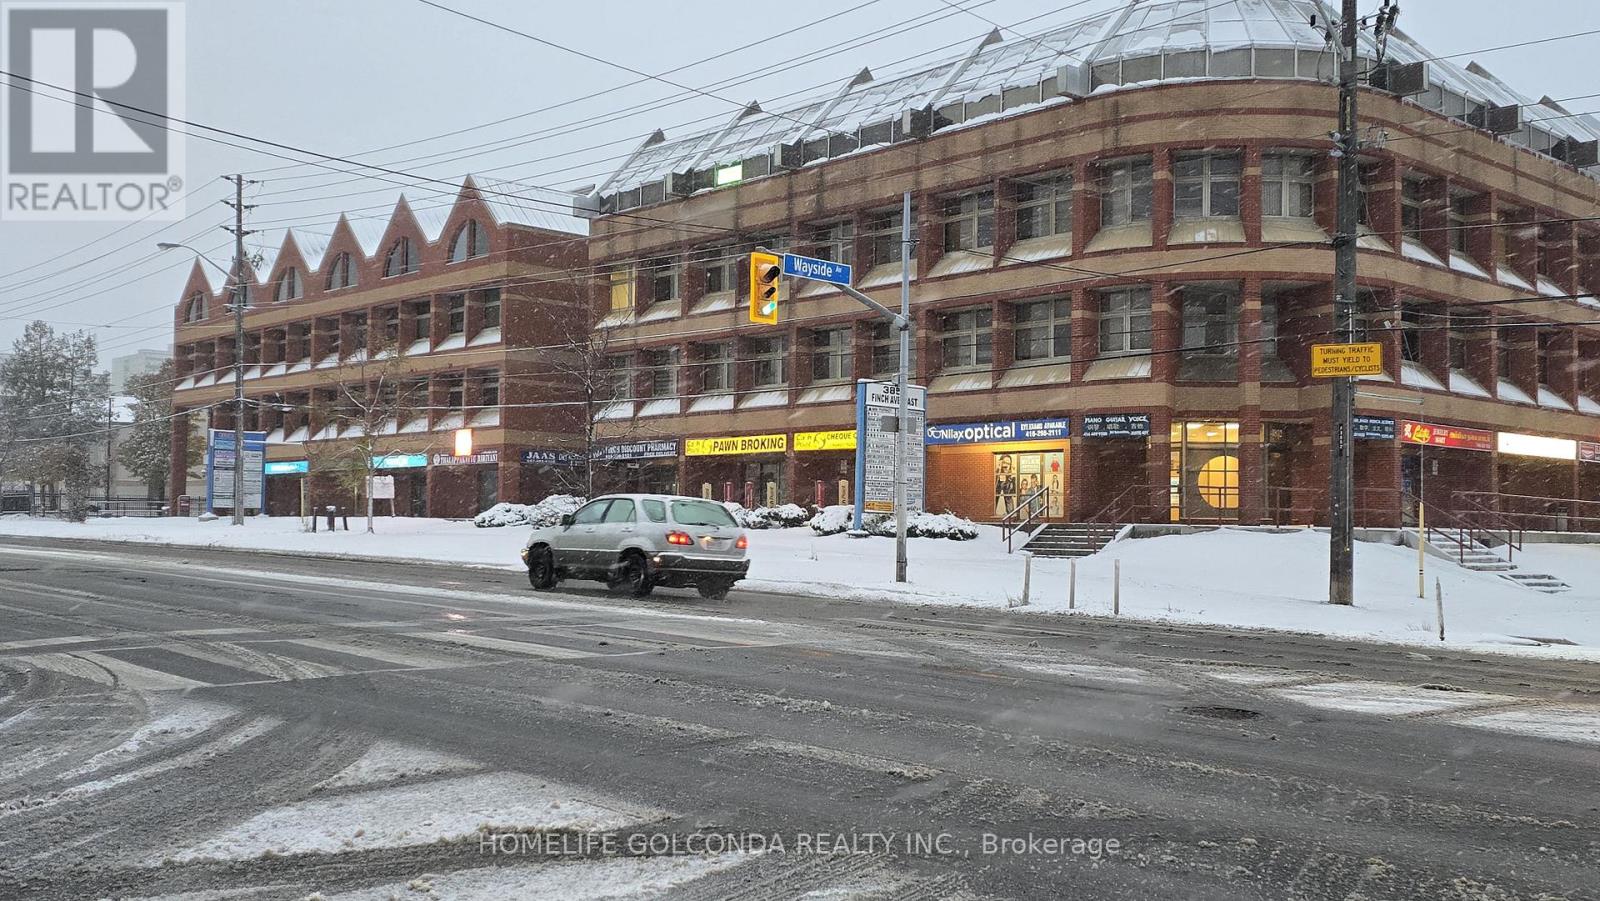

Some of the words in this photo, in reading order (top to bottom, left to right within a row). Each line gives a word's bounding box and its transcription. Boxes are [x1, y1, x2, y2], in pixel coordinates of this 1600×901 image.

[793, 257, 833, 278] Wayside
[1319, 347, 1346, 355] TURNING
[1348, 346, 1375, 354] TRAFFIC
[1313, 364, 1381, 374] PEDESTRIANS/CYCLISTS
[871, 393, 889, 404] FINCH
[826, 432, 852, 440] CHEQUE
[965, 421, 1016, 442] optical
[647, 441, 677, 452] PHARMACY
[713, 440, 738, 452] PAWN
[741, 437, 784, 450] BROKING
[526, 451, 556, 460] JAAS
